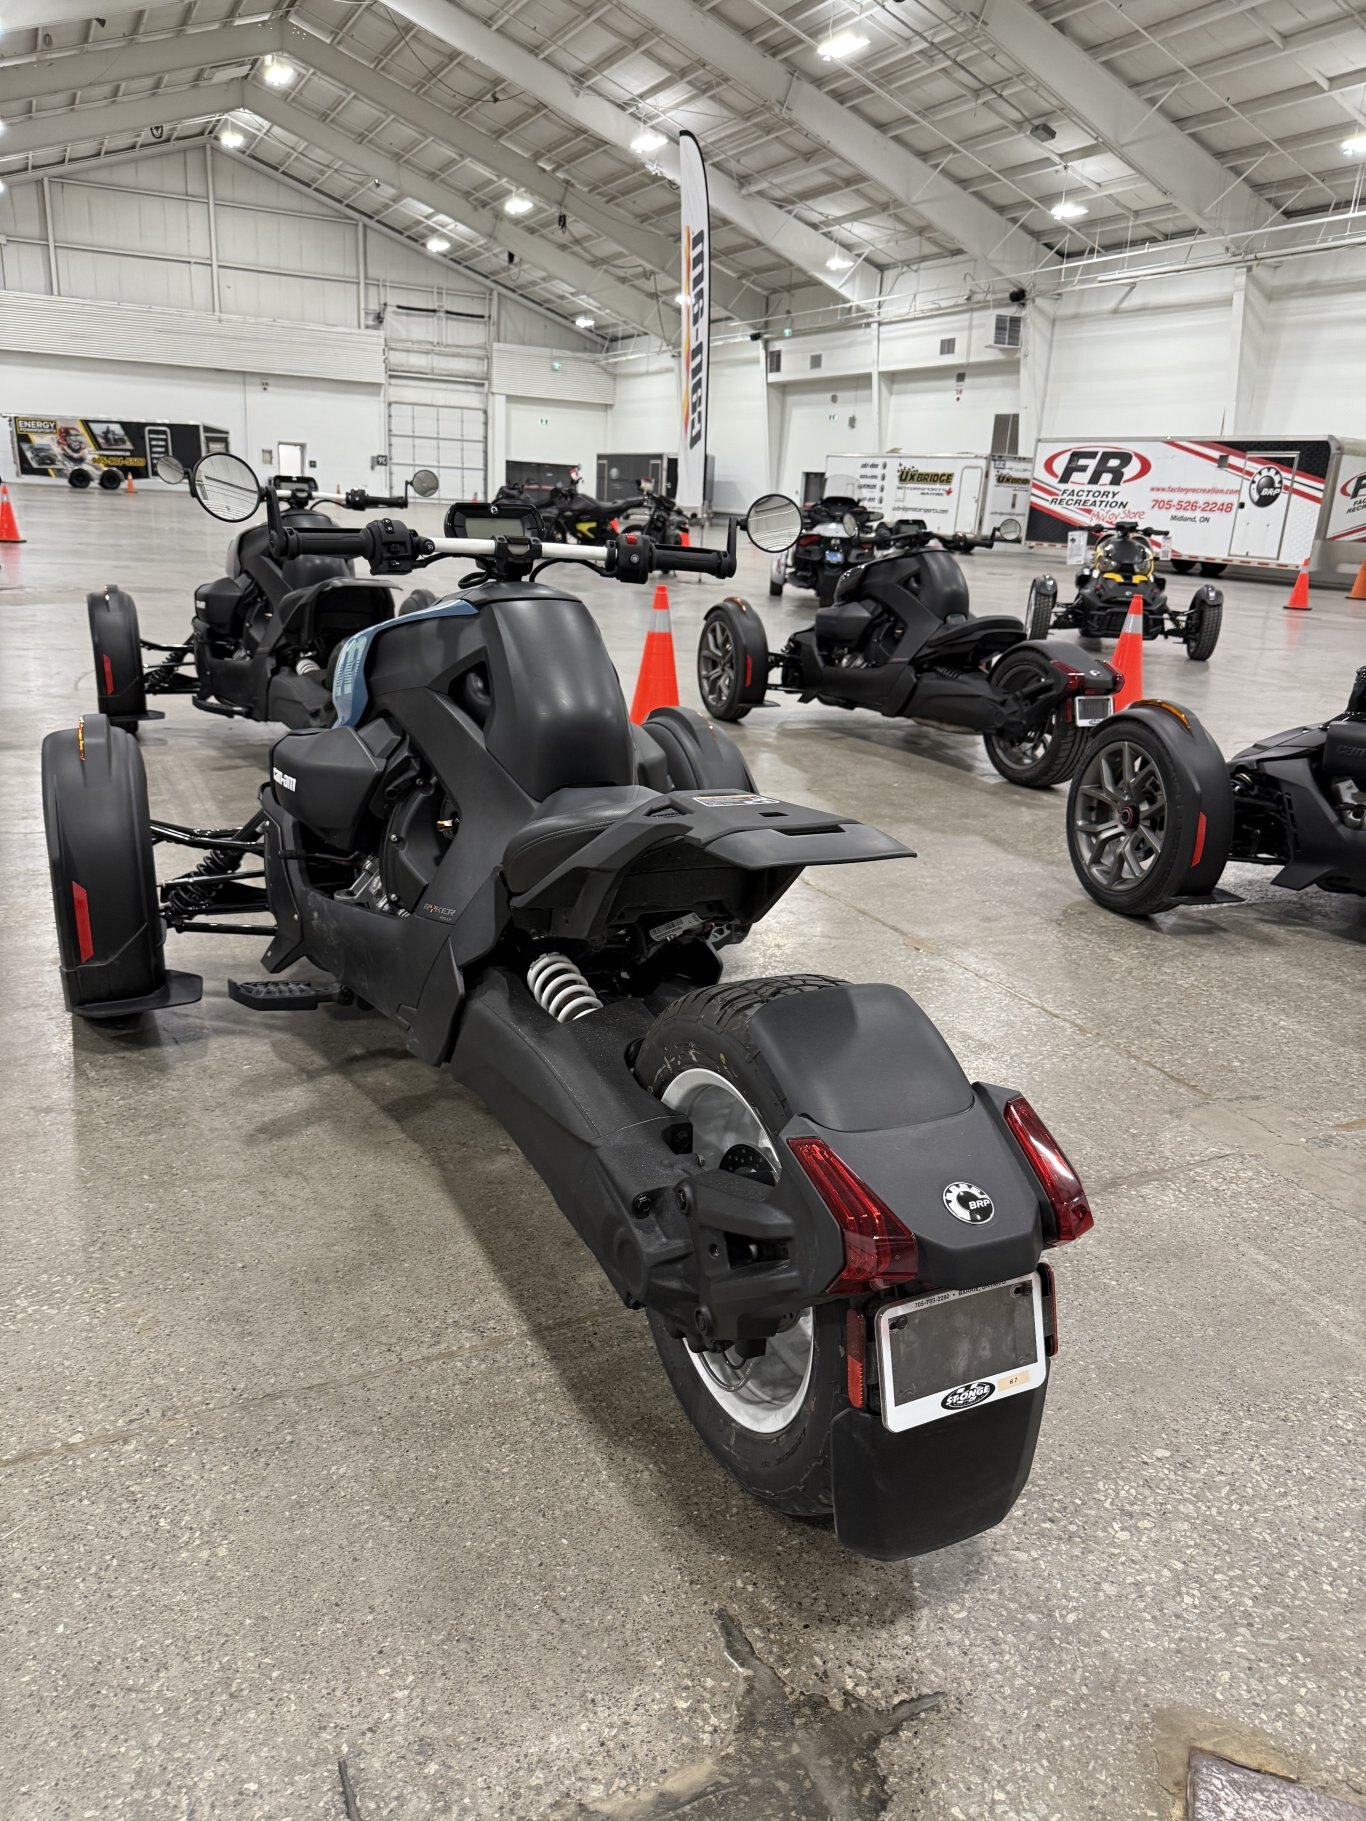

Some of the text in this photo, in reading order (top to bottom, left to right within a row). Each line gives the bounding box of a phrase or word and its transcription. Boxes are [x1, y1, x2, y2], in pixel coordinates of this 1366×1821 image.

[18, 420, 55, 429] ENERGY
[1058, 451, 1133, 486] FR
[899, 471, 954, 485] UXBRIDGE
[1060, 488, 1120, 499] FACTORY
[1150, 486, 1240, 496] www.factoryrecreation.com
[1260, 488, 1280, 496] BRP
[1049, 498, 1129, 509] RECREATION
[1151, 499, 1234, 513] 705-526-2248
[1104, 509, 1121, 522] Toy
[1120, 510, 1146, 520] Store
[1170, 514, 1197, 523] Midland,
[968, 1199, 991, 1210] BRP
